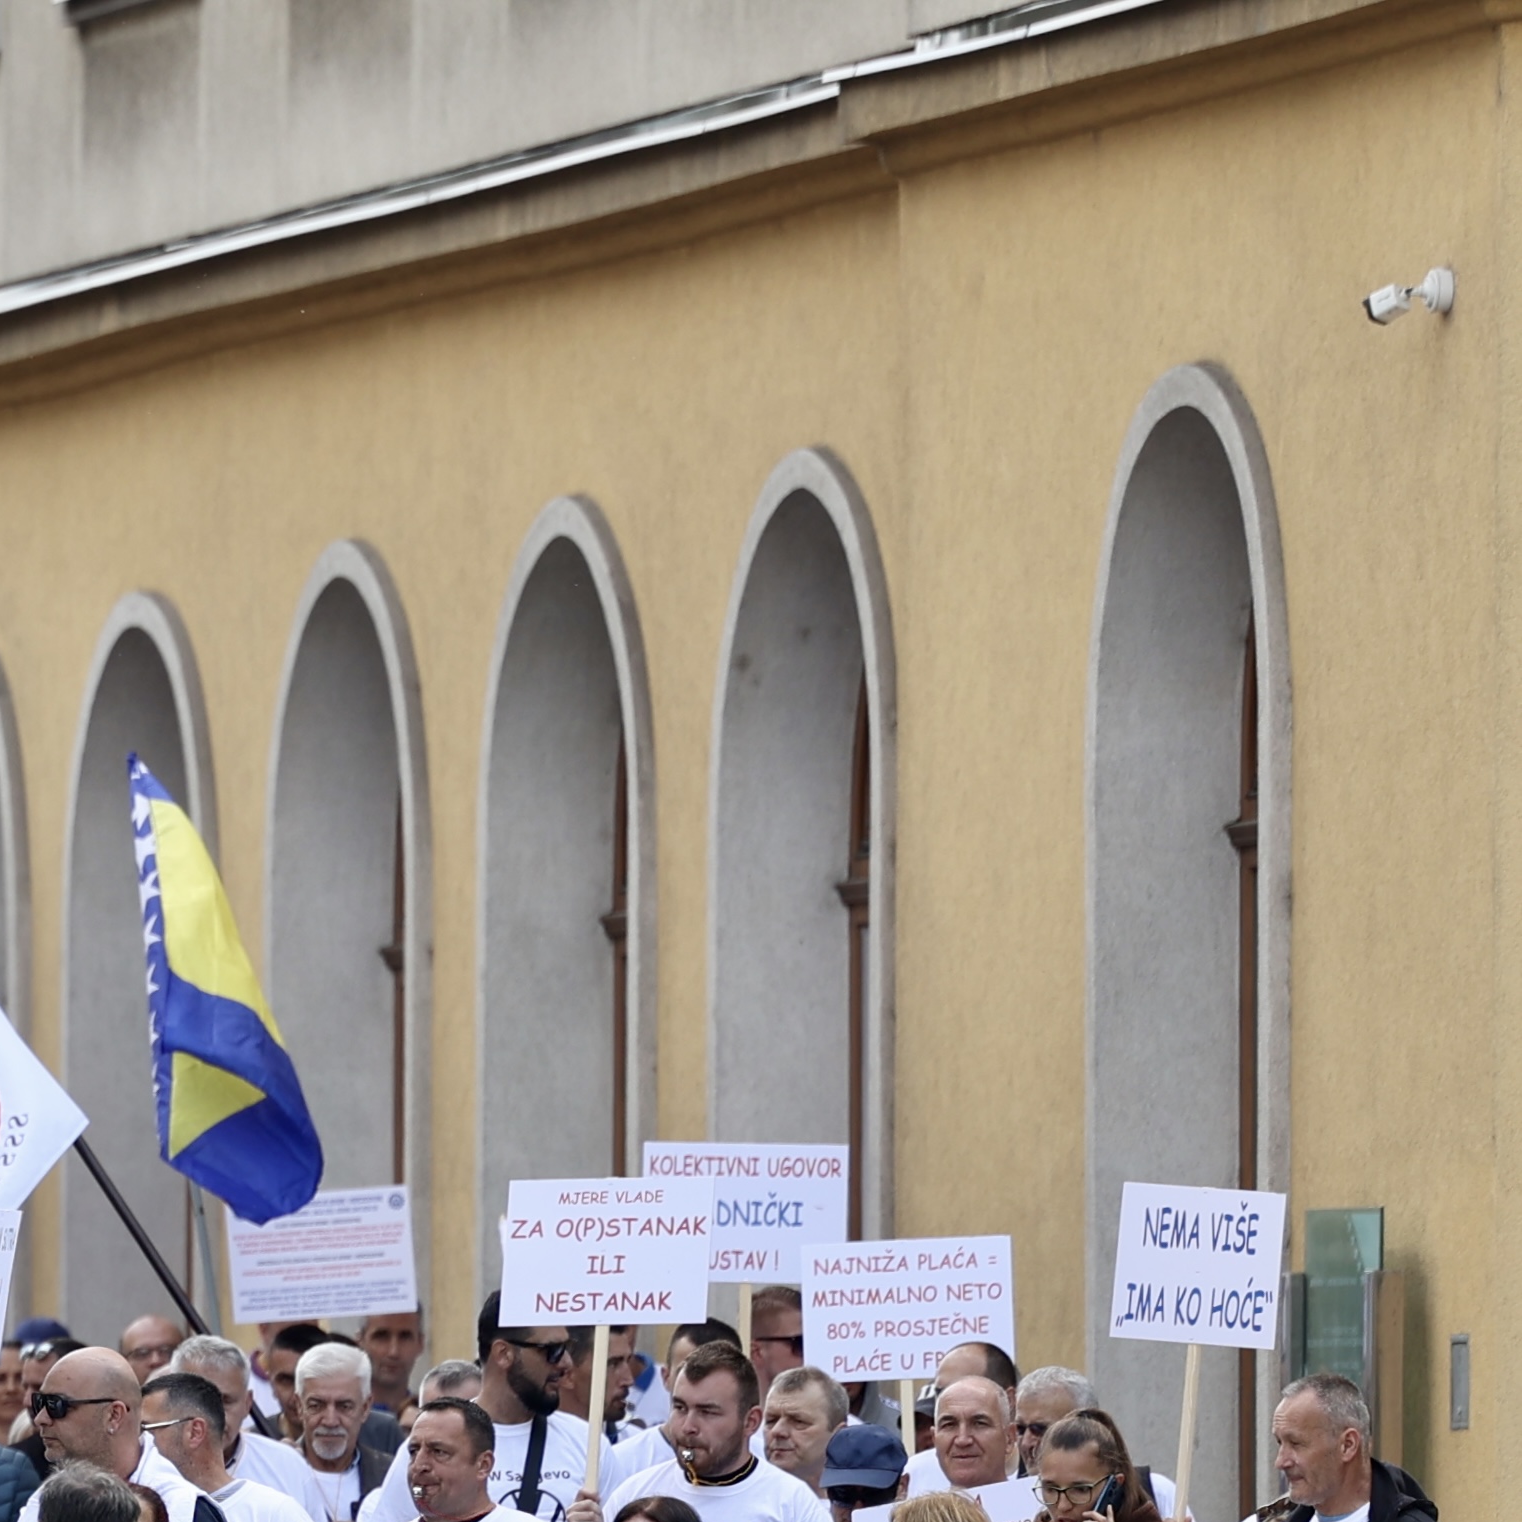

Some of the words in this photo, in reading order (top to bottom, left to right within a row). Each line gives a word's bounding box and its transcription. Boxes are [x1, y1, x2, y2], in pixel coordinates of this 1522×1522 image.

[649, 1155, 760, 1177] KOLEKTIVNI
[767, 1157, 842, 1178] UGOVOR
[559, 1190, 608, 1205] MJERE
[616, 1190, 664, 1204] VLADE
[714, 1192, 803, 1228] DNIČKI
[511, 1219, 543, 1239] ZA
[556, 1216, 707, 1242] O(P)STANAK
[1143, 1207, 1199, 1250] NEMA
[1212, 1201, 1259, 1255] VIŠE
[586, 1255, 626, 1275] ILI
[709, 1250, 767, 1271] USTAV
[774, 1250, 779, 1271] !
[813, 1249, 908, 1276] NAJNIŽA
[917, 1246, 978, 1271] PLAĆA
[535, 1291, 672, 1313] NESTANAK
[812, 1285, 937, 1308] MINIMALNO
[946, 1282, 1003, 1303] NETO
[1174, 1286, 1202, 1326] KO
[827, 1320, 866, 1340] 80%
[874, 1312, 990, 1338] PROSJEČNE
[833, 1348, 892, 1373] PLAĆE
[900, 1353, 914, 1371] U
